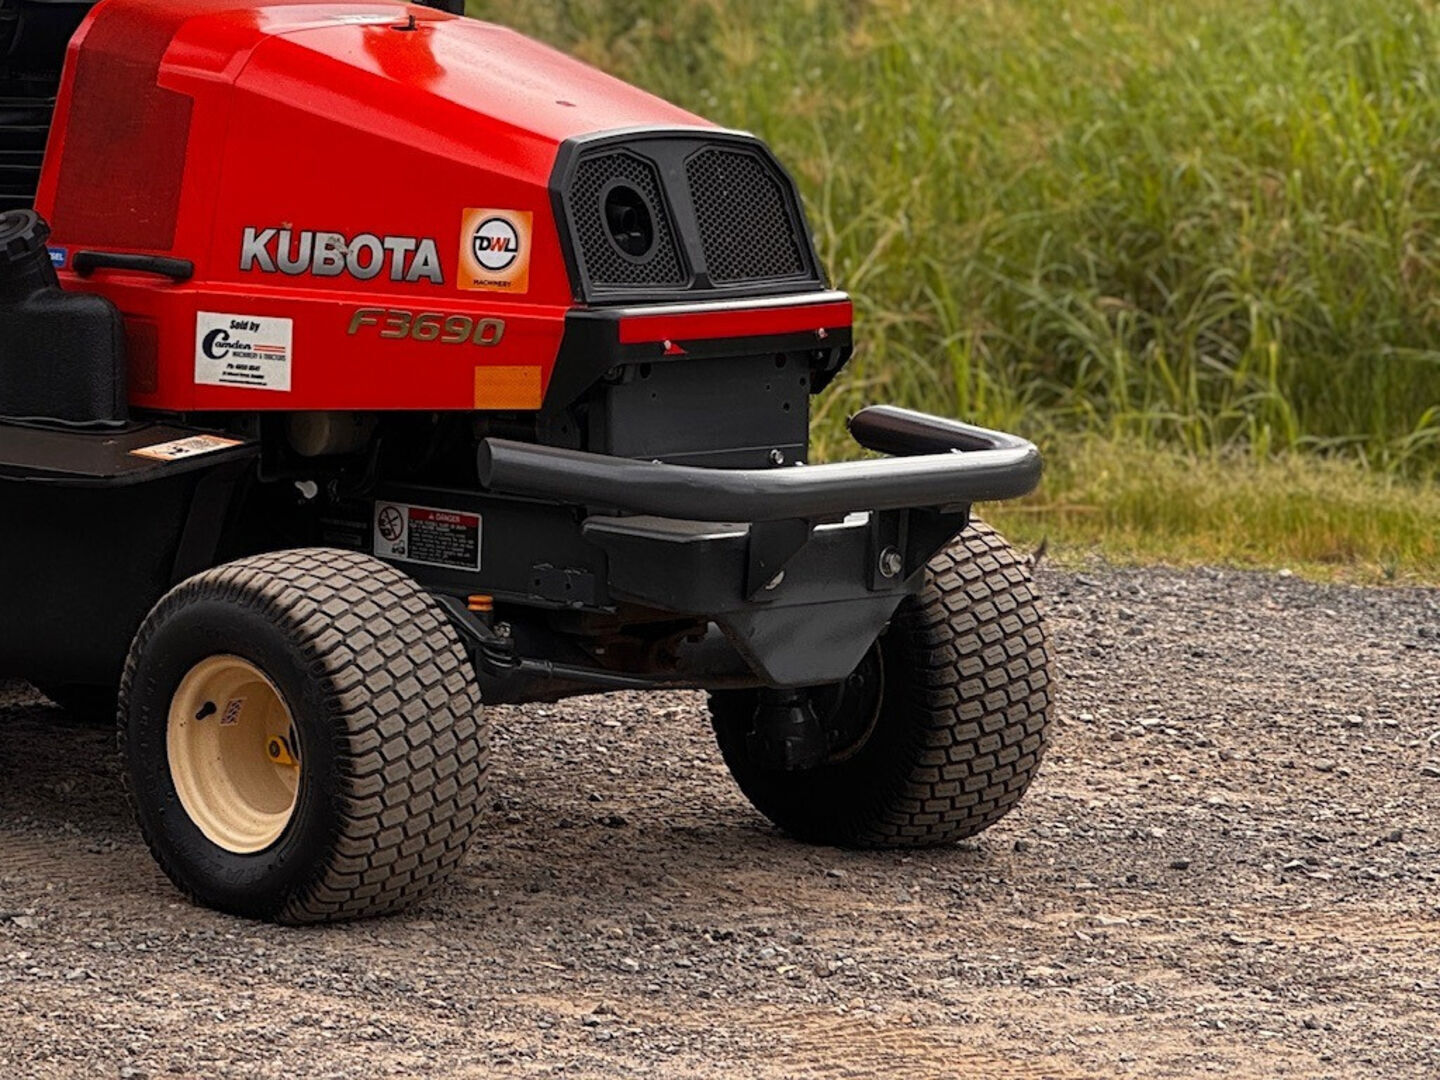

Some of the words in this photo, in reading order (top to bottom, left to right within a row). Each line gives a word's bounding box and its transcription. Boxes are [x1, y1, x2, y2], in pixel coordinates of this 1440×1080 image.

[474, 235, 518, 253] DWL
[240, 225, 445, 284] KUBOTA
[473, 279, 512, 288] MACHINERY
[230, 320, 248, 330] Sold
[249, 322, 260, 332] by
[347, 307, 505, 347] F3690
[203, 329, 251, 359] Camden
[435, 512, 461, 523] DANGER
